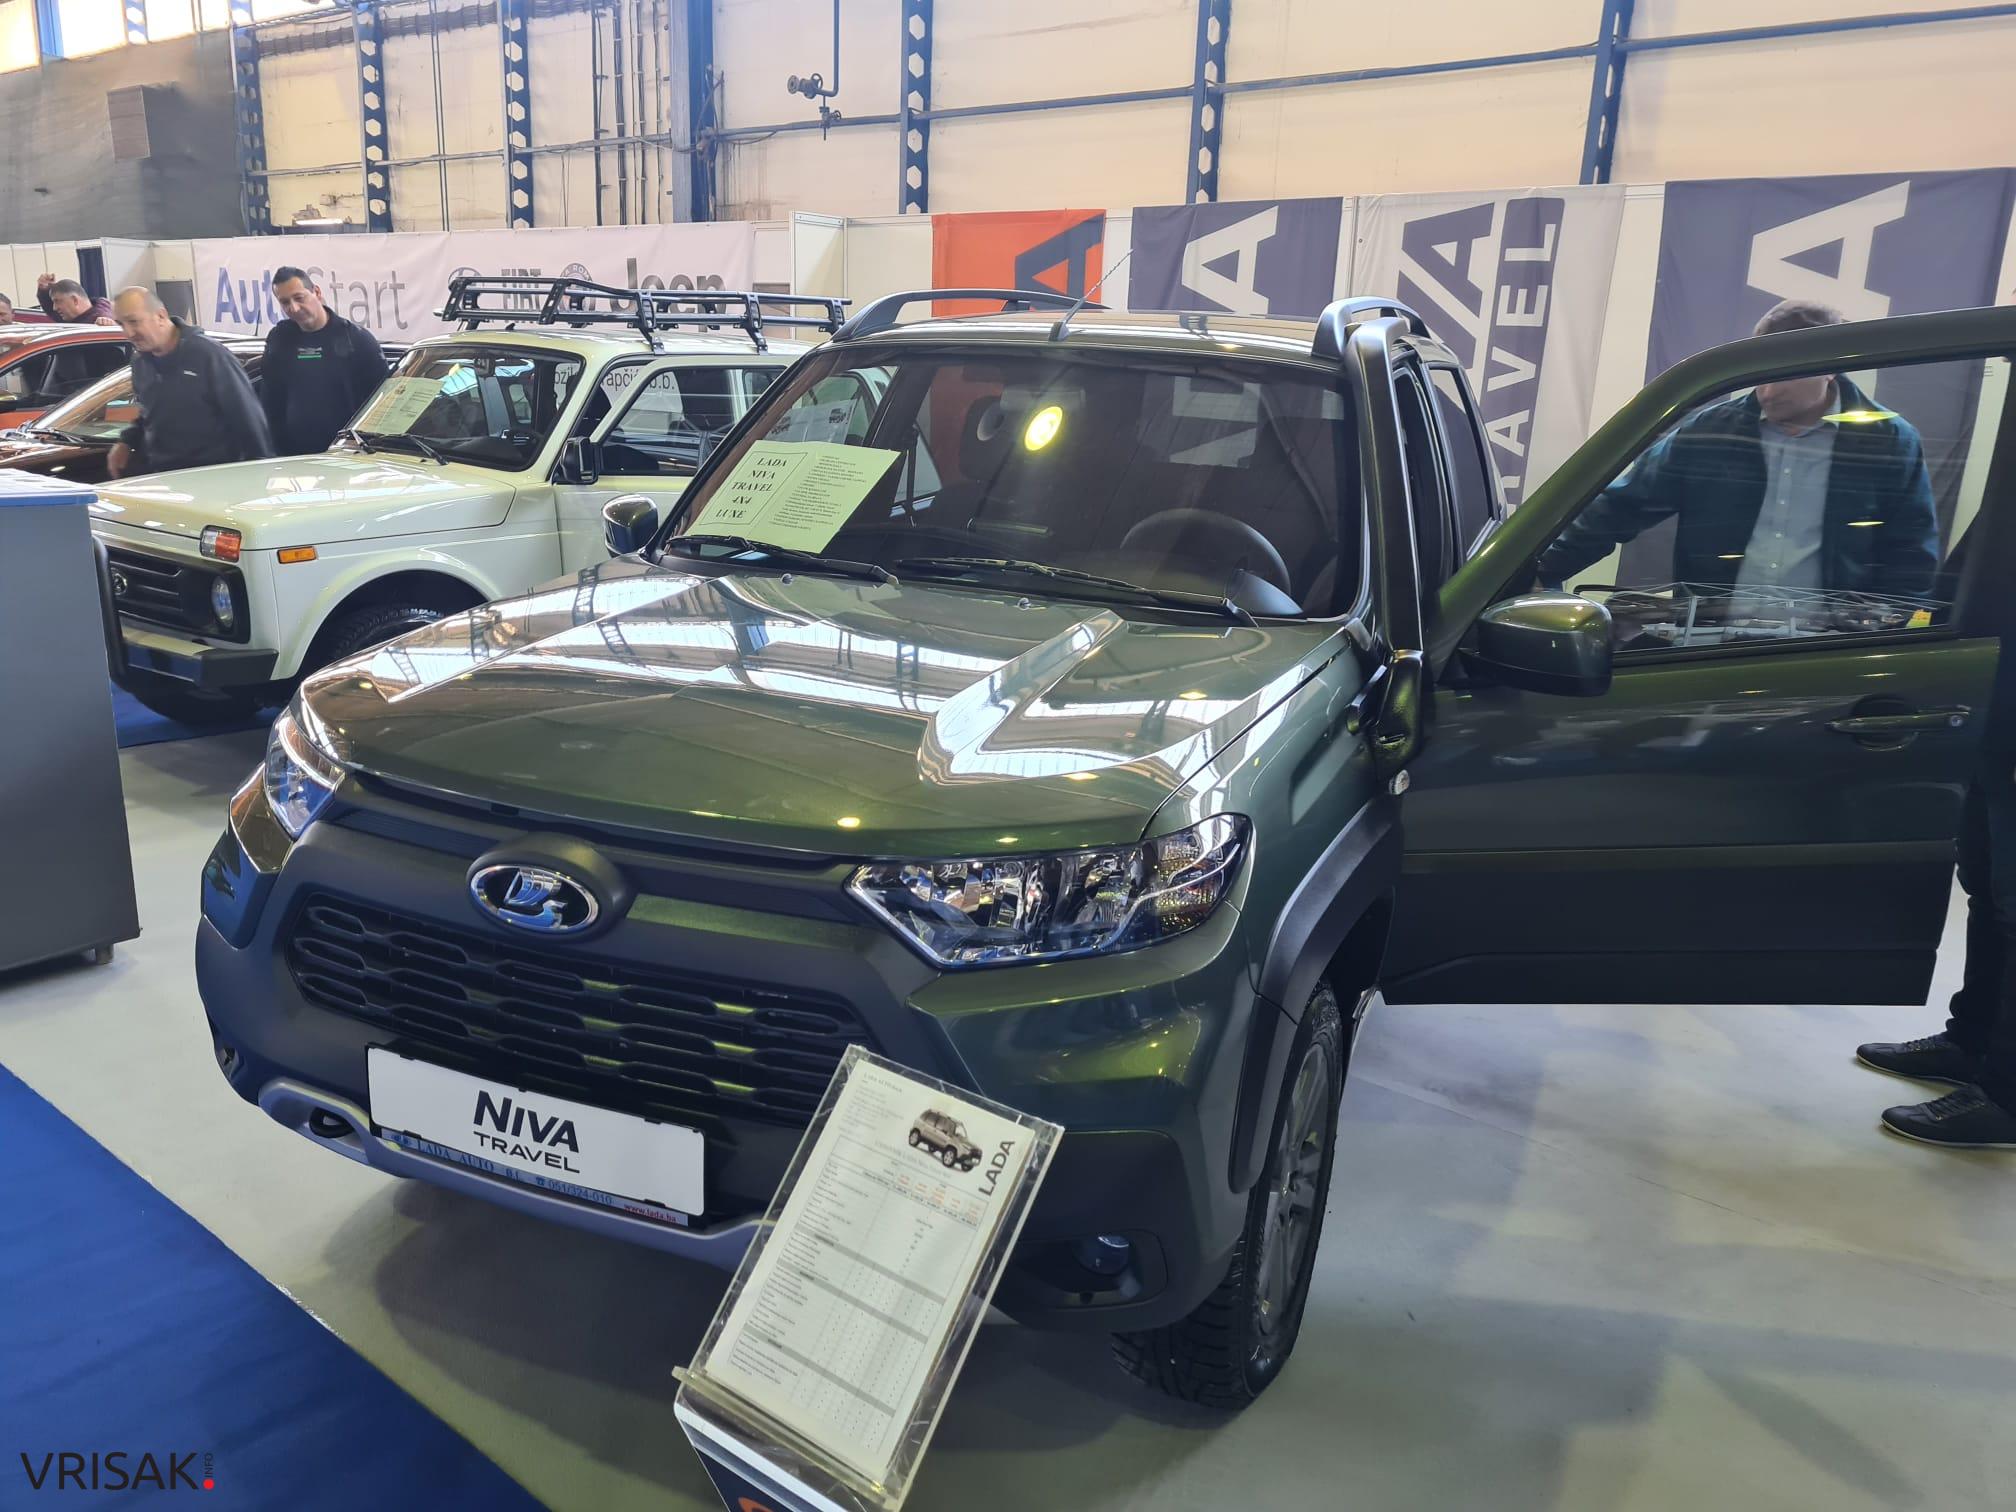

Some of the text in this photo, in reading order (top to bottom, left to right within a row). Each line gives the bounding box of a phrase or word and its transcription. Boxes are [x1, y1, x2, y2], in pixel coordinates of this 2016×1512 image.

[757, 457, 788, 467] LADA
[749, 469, 776, 479] NIVA
[731, 481, 773, 492] TRAVEL
[417, 1139, 452, 1161] LADA
[460, 1153, 495, 1172] AUTO
[473, 1131, 580, 1174] TRAVEL
[978, 1141, 1015, 1196] LADA
